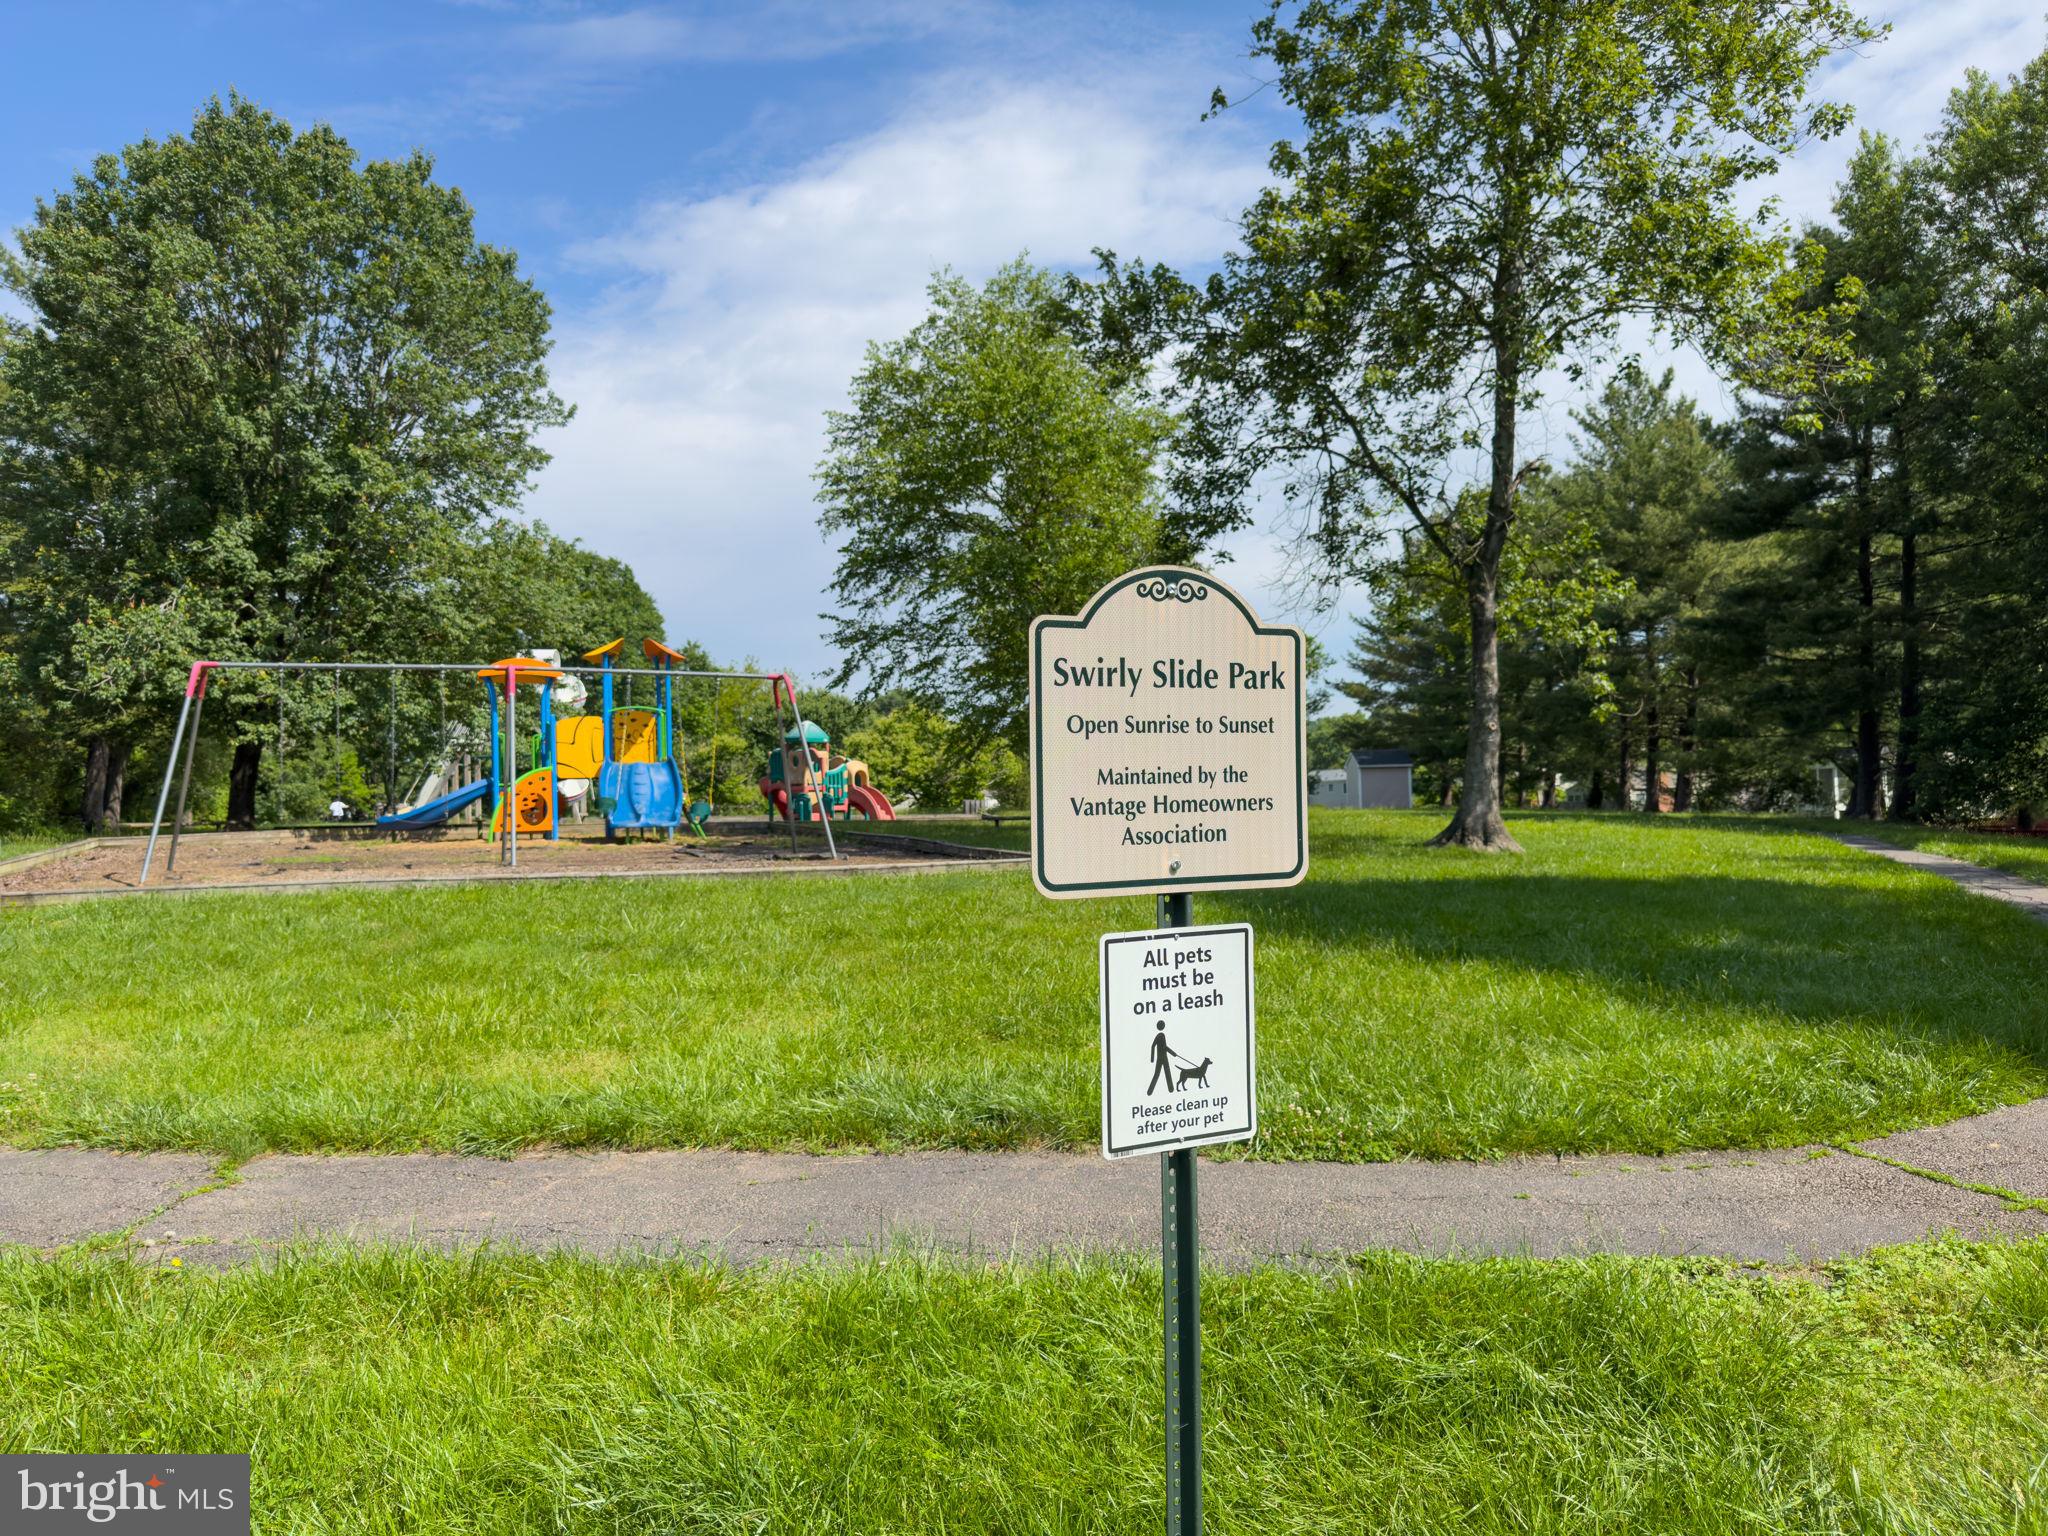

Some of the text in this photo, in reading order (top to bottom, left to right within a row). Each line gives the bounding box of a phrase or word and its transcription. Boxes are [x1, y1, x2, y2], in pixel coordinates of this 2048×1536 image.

[1053, 657, 1285, 697] Swirly Slide Park
[1067, 715, 1274, 739] Open Sunrise to Sunset
[1097, 765, 1248, 788] Maintained by the
[1070, 795, 1273, 821] Vantage Homeowners
[1122, 824, 1227, 845] Association
[1143, 948, 1212, 969] All pets
[1143, 969, 1214, 990] must be
[1134, 989, 1223, 1015] on a leash
[1132, 1096, 1228, 1118] Please clean up
[1137, 1111, 1223, 1134] after your pet
